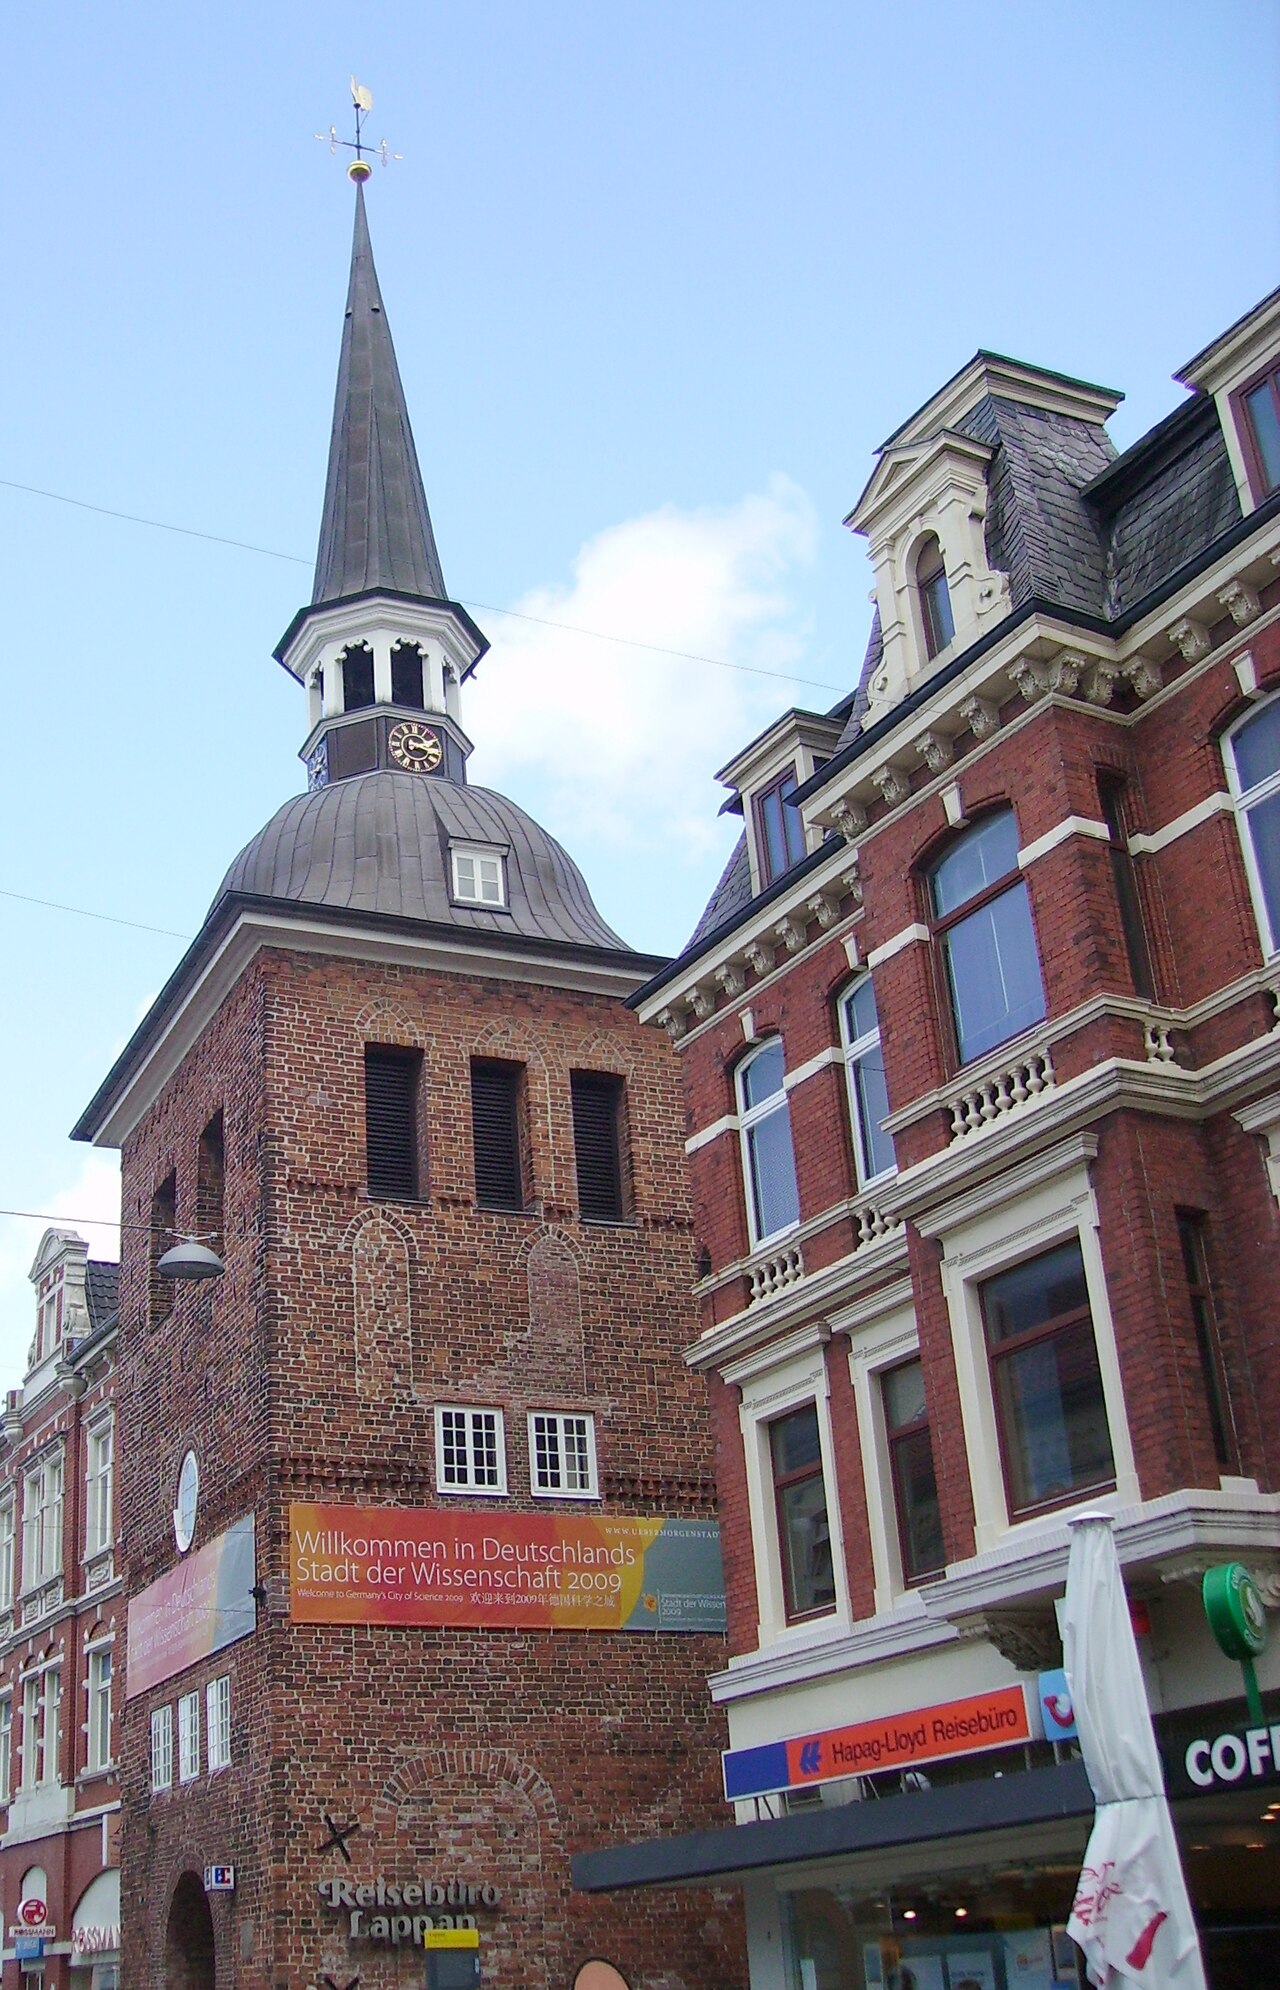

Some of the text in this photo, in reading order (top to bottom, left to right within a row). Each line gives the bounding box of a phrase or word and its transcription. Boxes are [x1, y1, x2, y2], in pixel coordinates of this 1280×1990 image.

[295, 1530, 636, 1565] Willkommen in Deutschlands
[296, 1557, 623, 1594] Stadt der Wissenschaft 2009
[296, 1588, 464, 1603] Welcome to Germany's City of Science 2009
[831, 1707, 1018, 1767] Hapag-Lloyd Reisebüro
[318, 1875, 501, 1908] Reisebüro
[350, 1910, 476, 1944] Lappan
